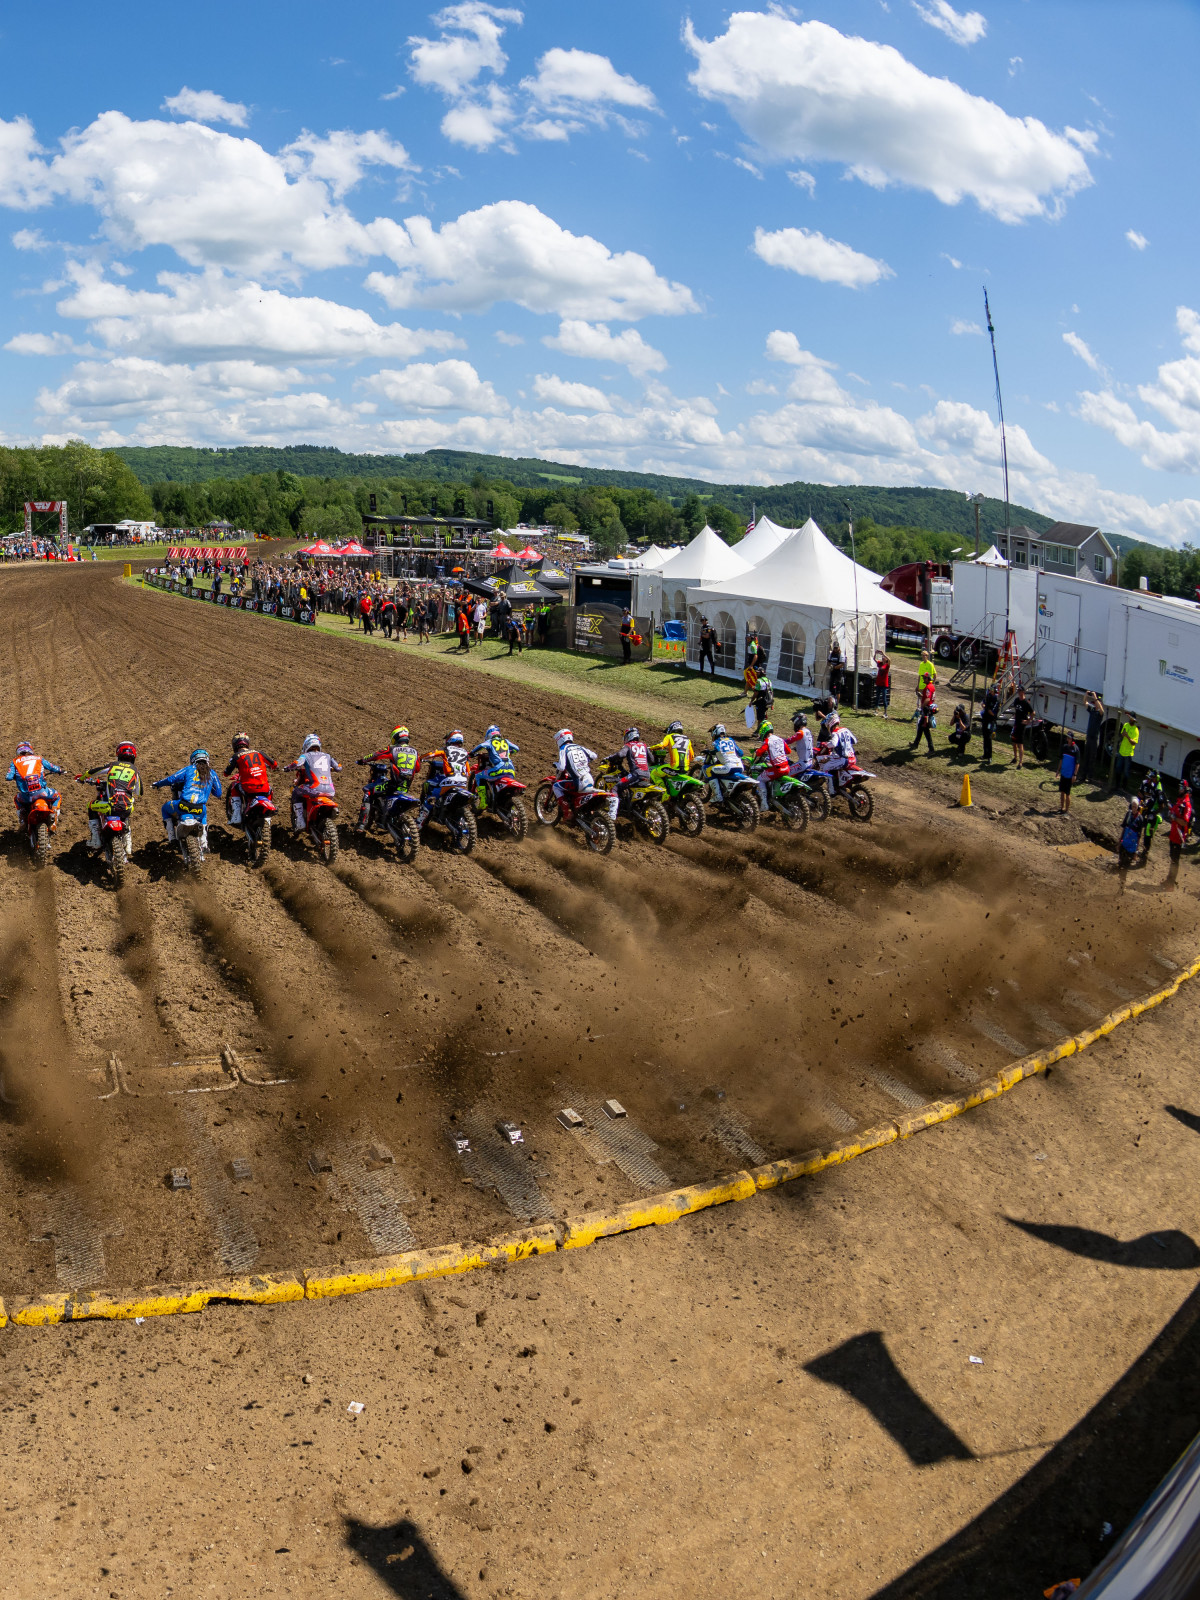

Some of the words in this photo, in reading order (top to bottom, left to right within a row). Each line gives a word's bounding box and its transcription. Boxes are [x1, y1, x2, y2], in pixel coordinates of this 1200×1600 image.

[492, 740, 508, 751] 96
[672, 736, 690, 750] 21
[720, 740, 735, 752] 28
[448, 751, 468, 765] 32
[632, 745, 646, 757] 94
[23, 760, 36, 774] 7
[244, 754, 262, 768] 14
[314, 756, 328, 772] 4
[397, 752, 416, 770] 23
[109, 766, 136, 782] 58
